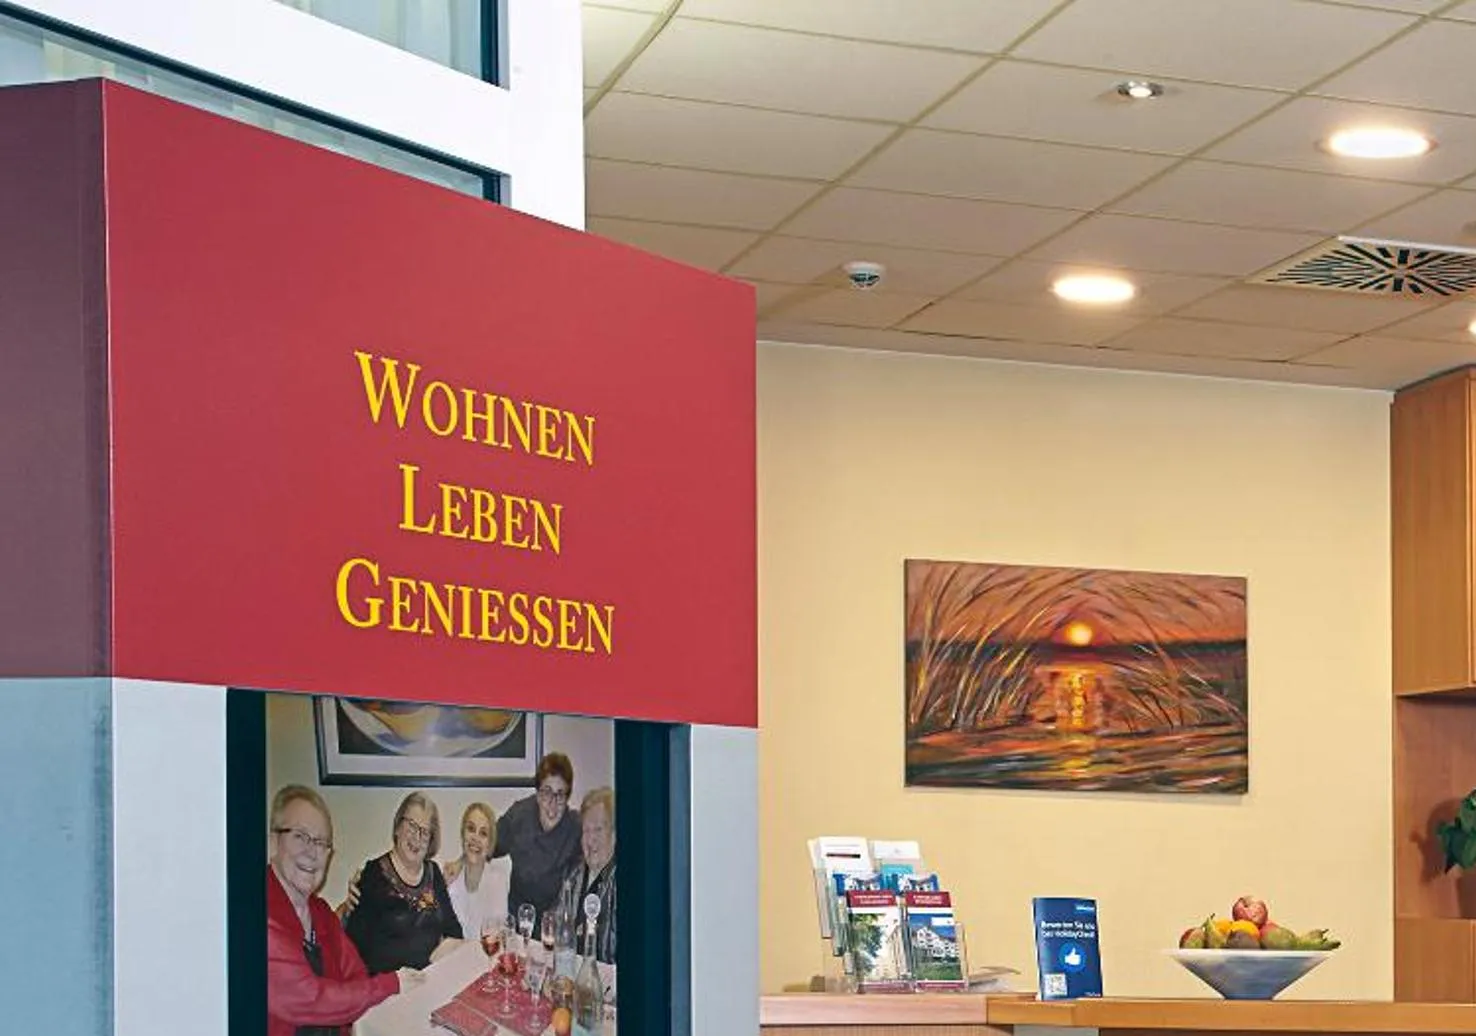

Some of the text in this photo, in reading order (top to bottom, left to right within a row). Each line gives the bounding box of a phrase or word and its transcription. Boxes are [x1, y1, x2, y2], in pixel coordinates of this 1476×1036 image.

[354, 350, 596, 466] WOHNEN
[398, 463, 563, 555] LEBEN
[336, 558, 615, 655] GENIESSEN
